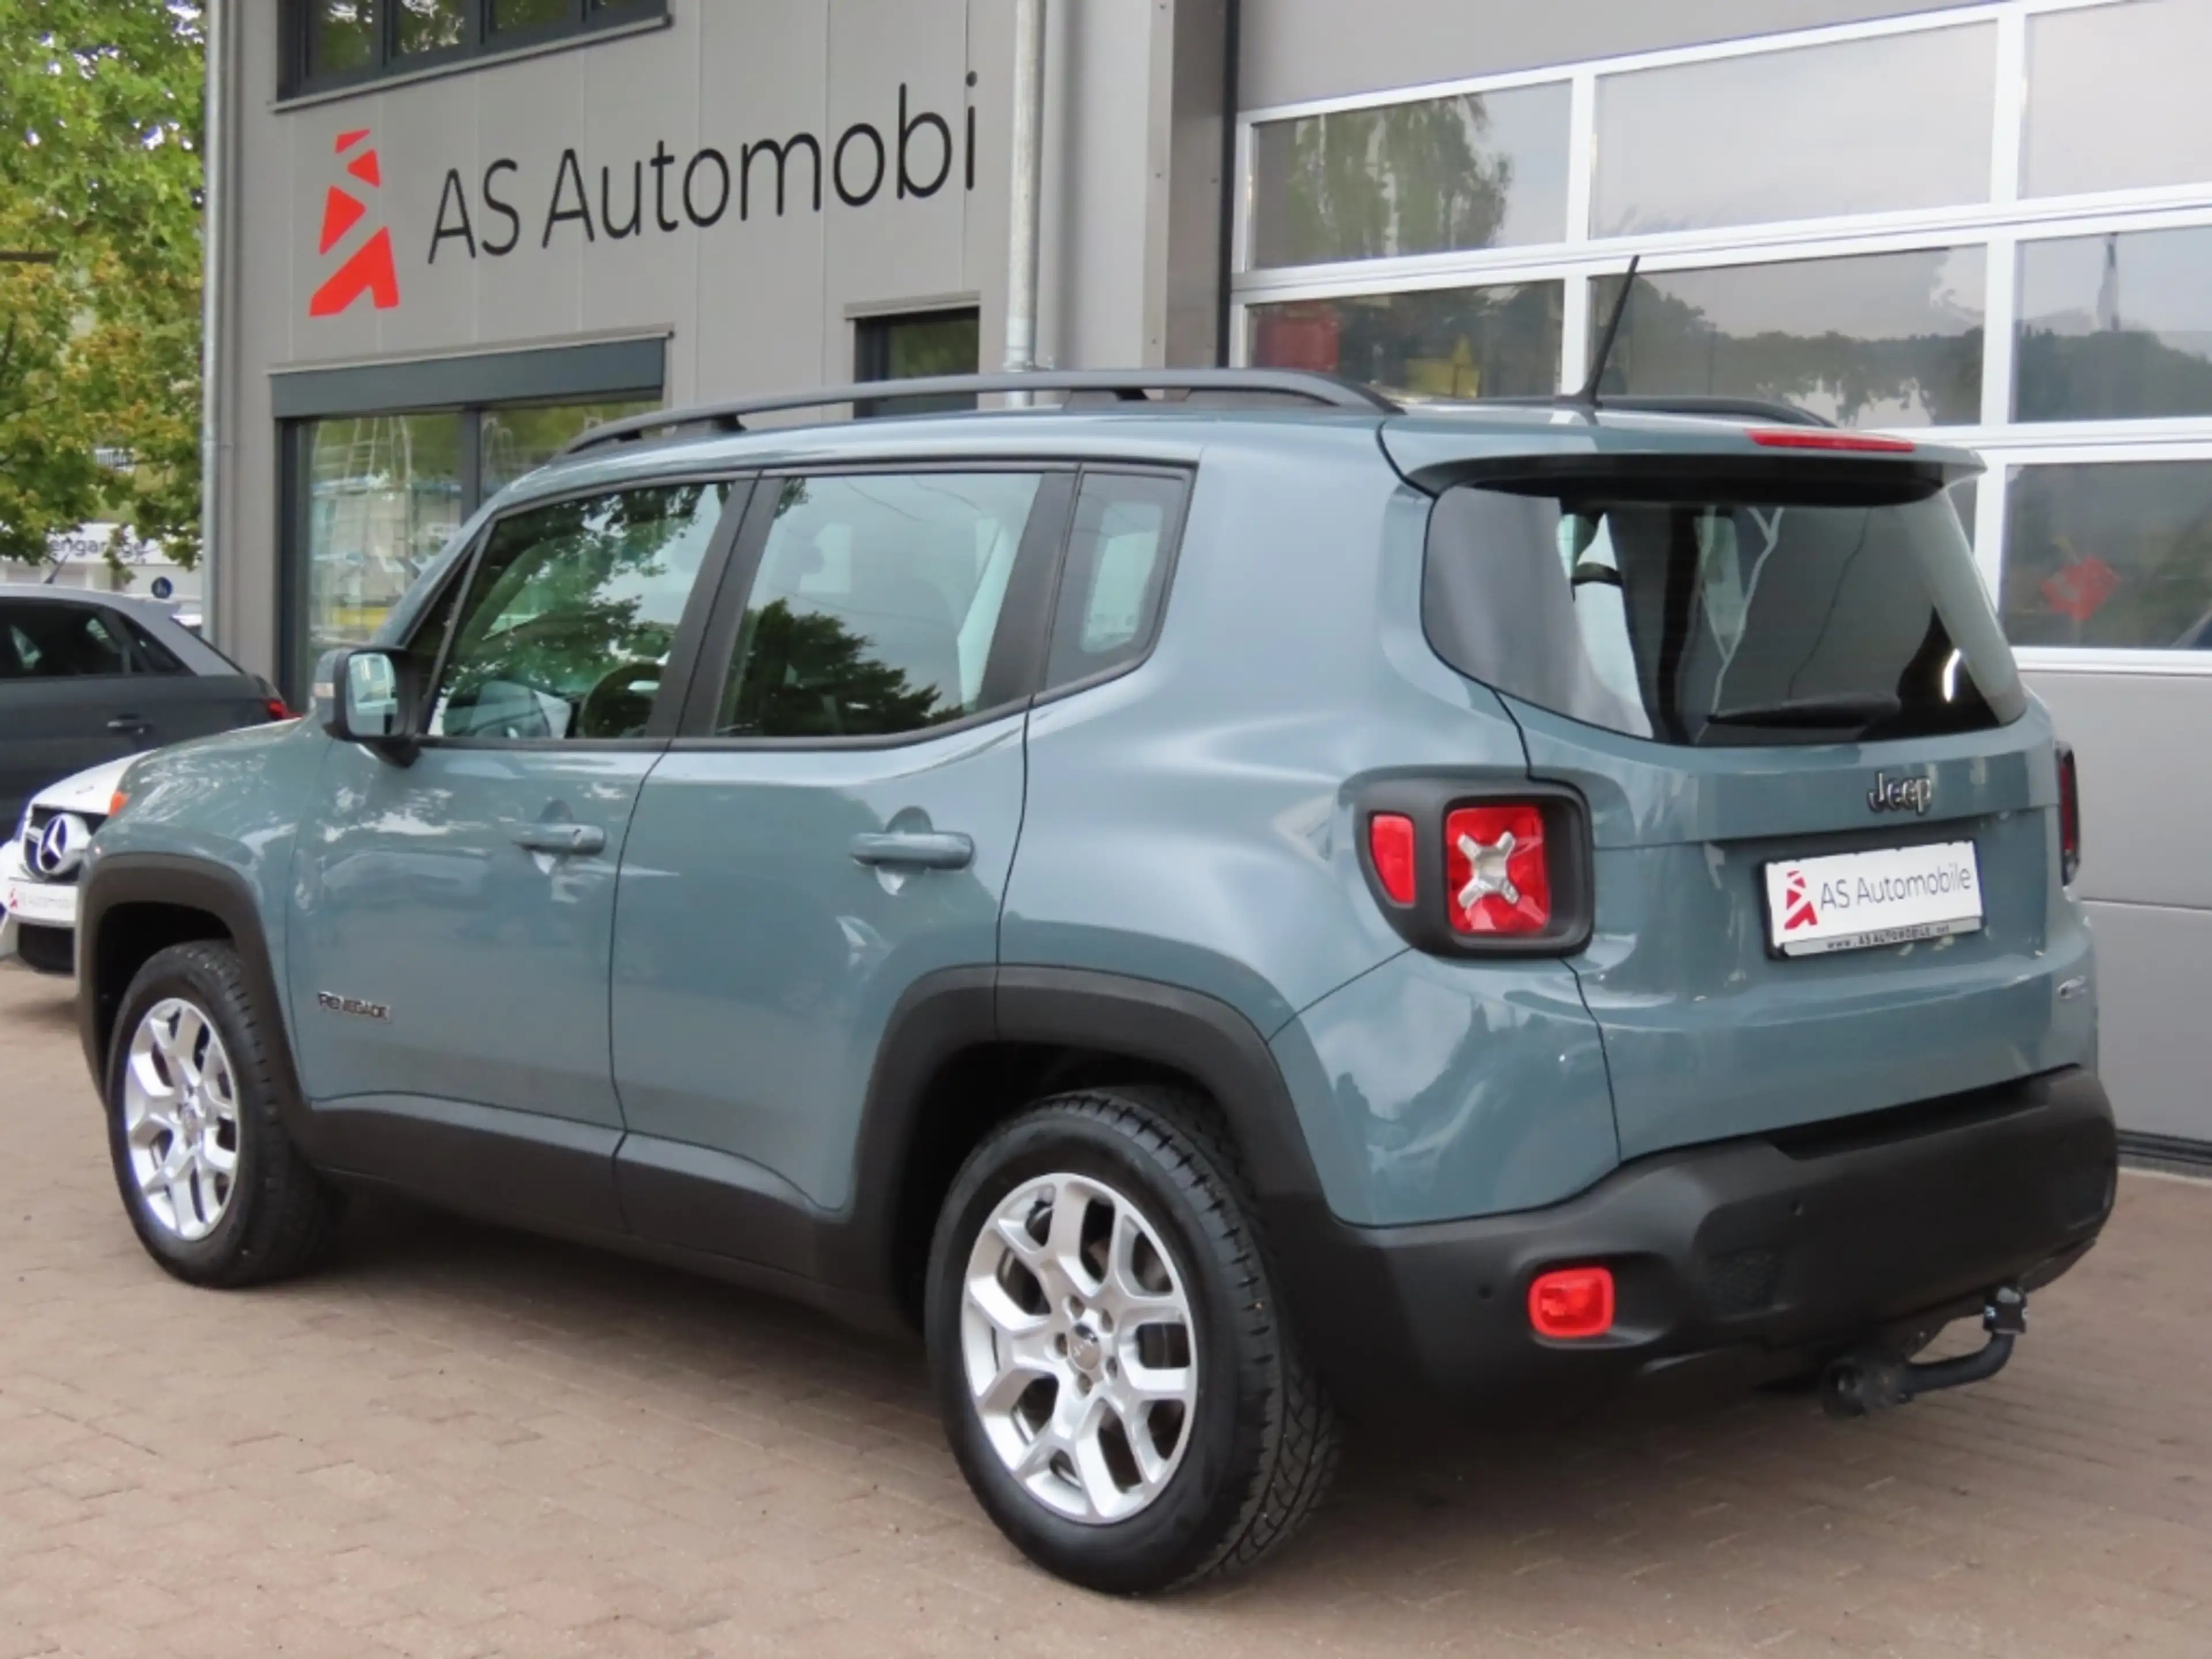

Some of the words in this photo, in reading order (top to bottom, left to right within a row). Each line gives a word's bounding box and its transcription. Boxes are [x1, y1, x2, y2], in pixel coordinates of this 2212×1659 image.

[427, 158, 521, 264] AS
[541, 70, 978, 249] Automobi
[1866, 771, 1932, 816] Jeep
[1820, 878, 1850, 911] AS
[1857, 863, 1971, 907] Automobile
